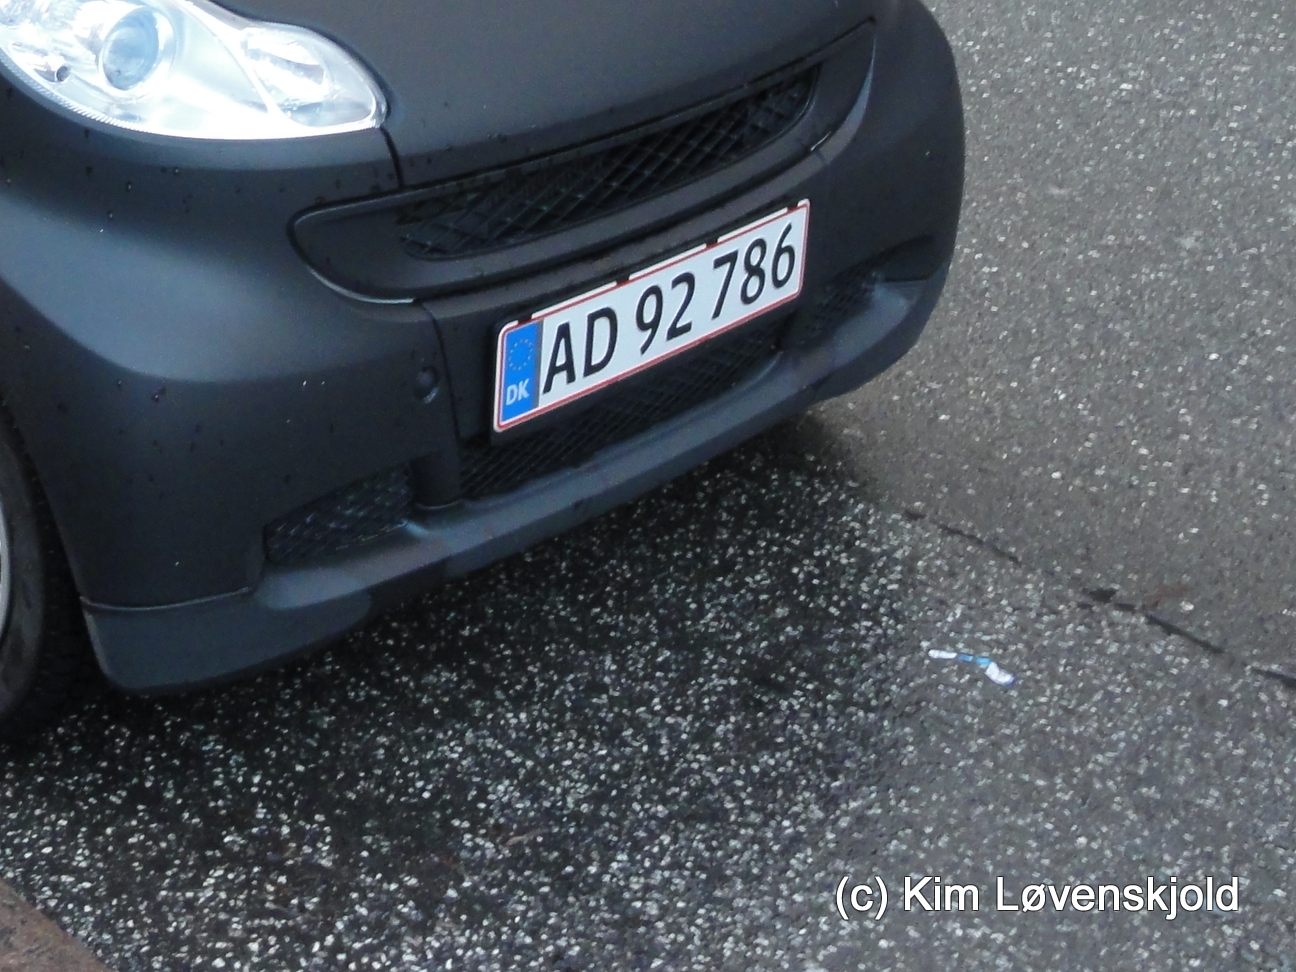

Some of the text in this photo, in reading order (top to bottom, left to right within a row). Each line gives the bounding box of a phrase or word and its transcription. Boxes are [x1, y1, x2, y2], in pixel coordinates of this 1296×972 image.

[542, 222, 796, 395] AD 92 786
[505, 378, 530, 406] DK
